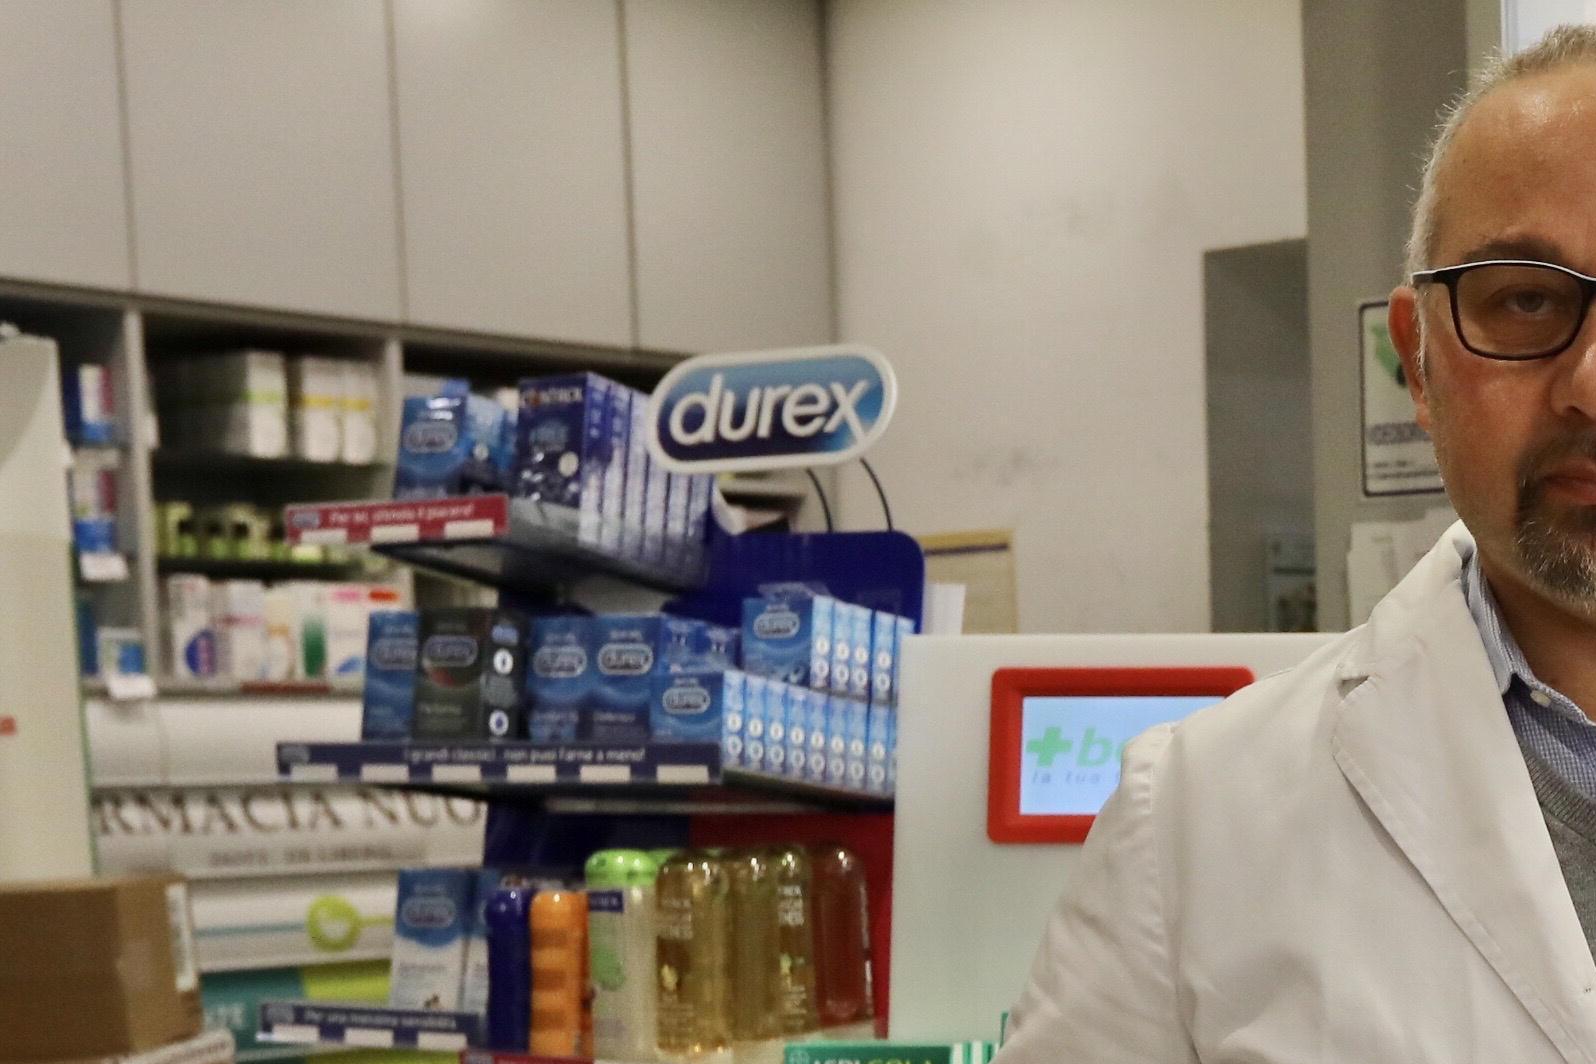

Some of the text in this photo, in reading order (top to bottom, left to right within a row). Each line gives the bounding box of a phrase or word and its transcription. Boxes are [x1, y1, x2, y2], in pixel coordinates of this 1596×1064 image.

[669, 373, 868, 450] durex
[100, 785, 482, 834] RMACIA NUO
